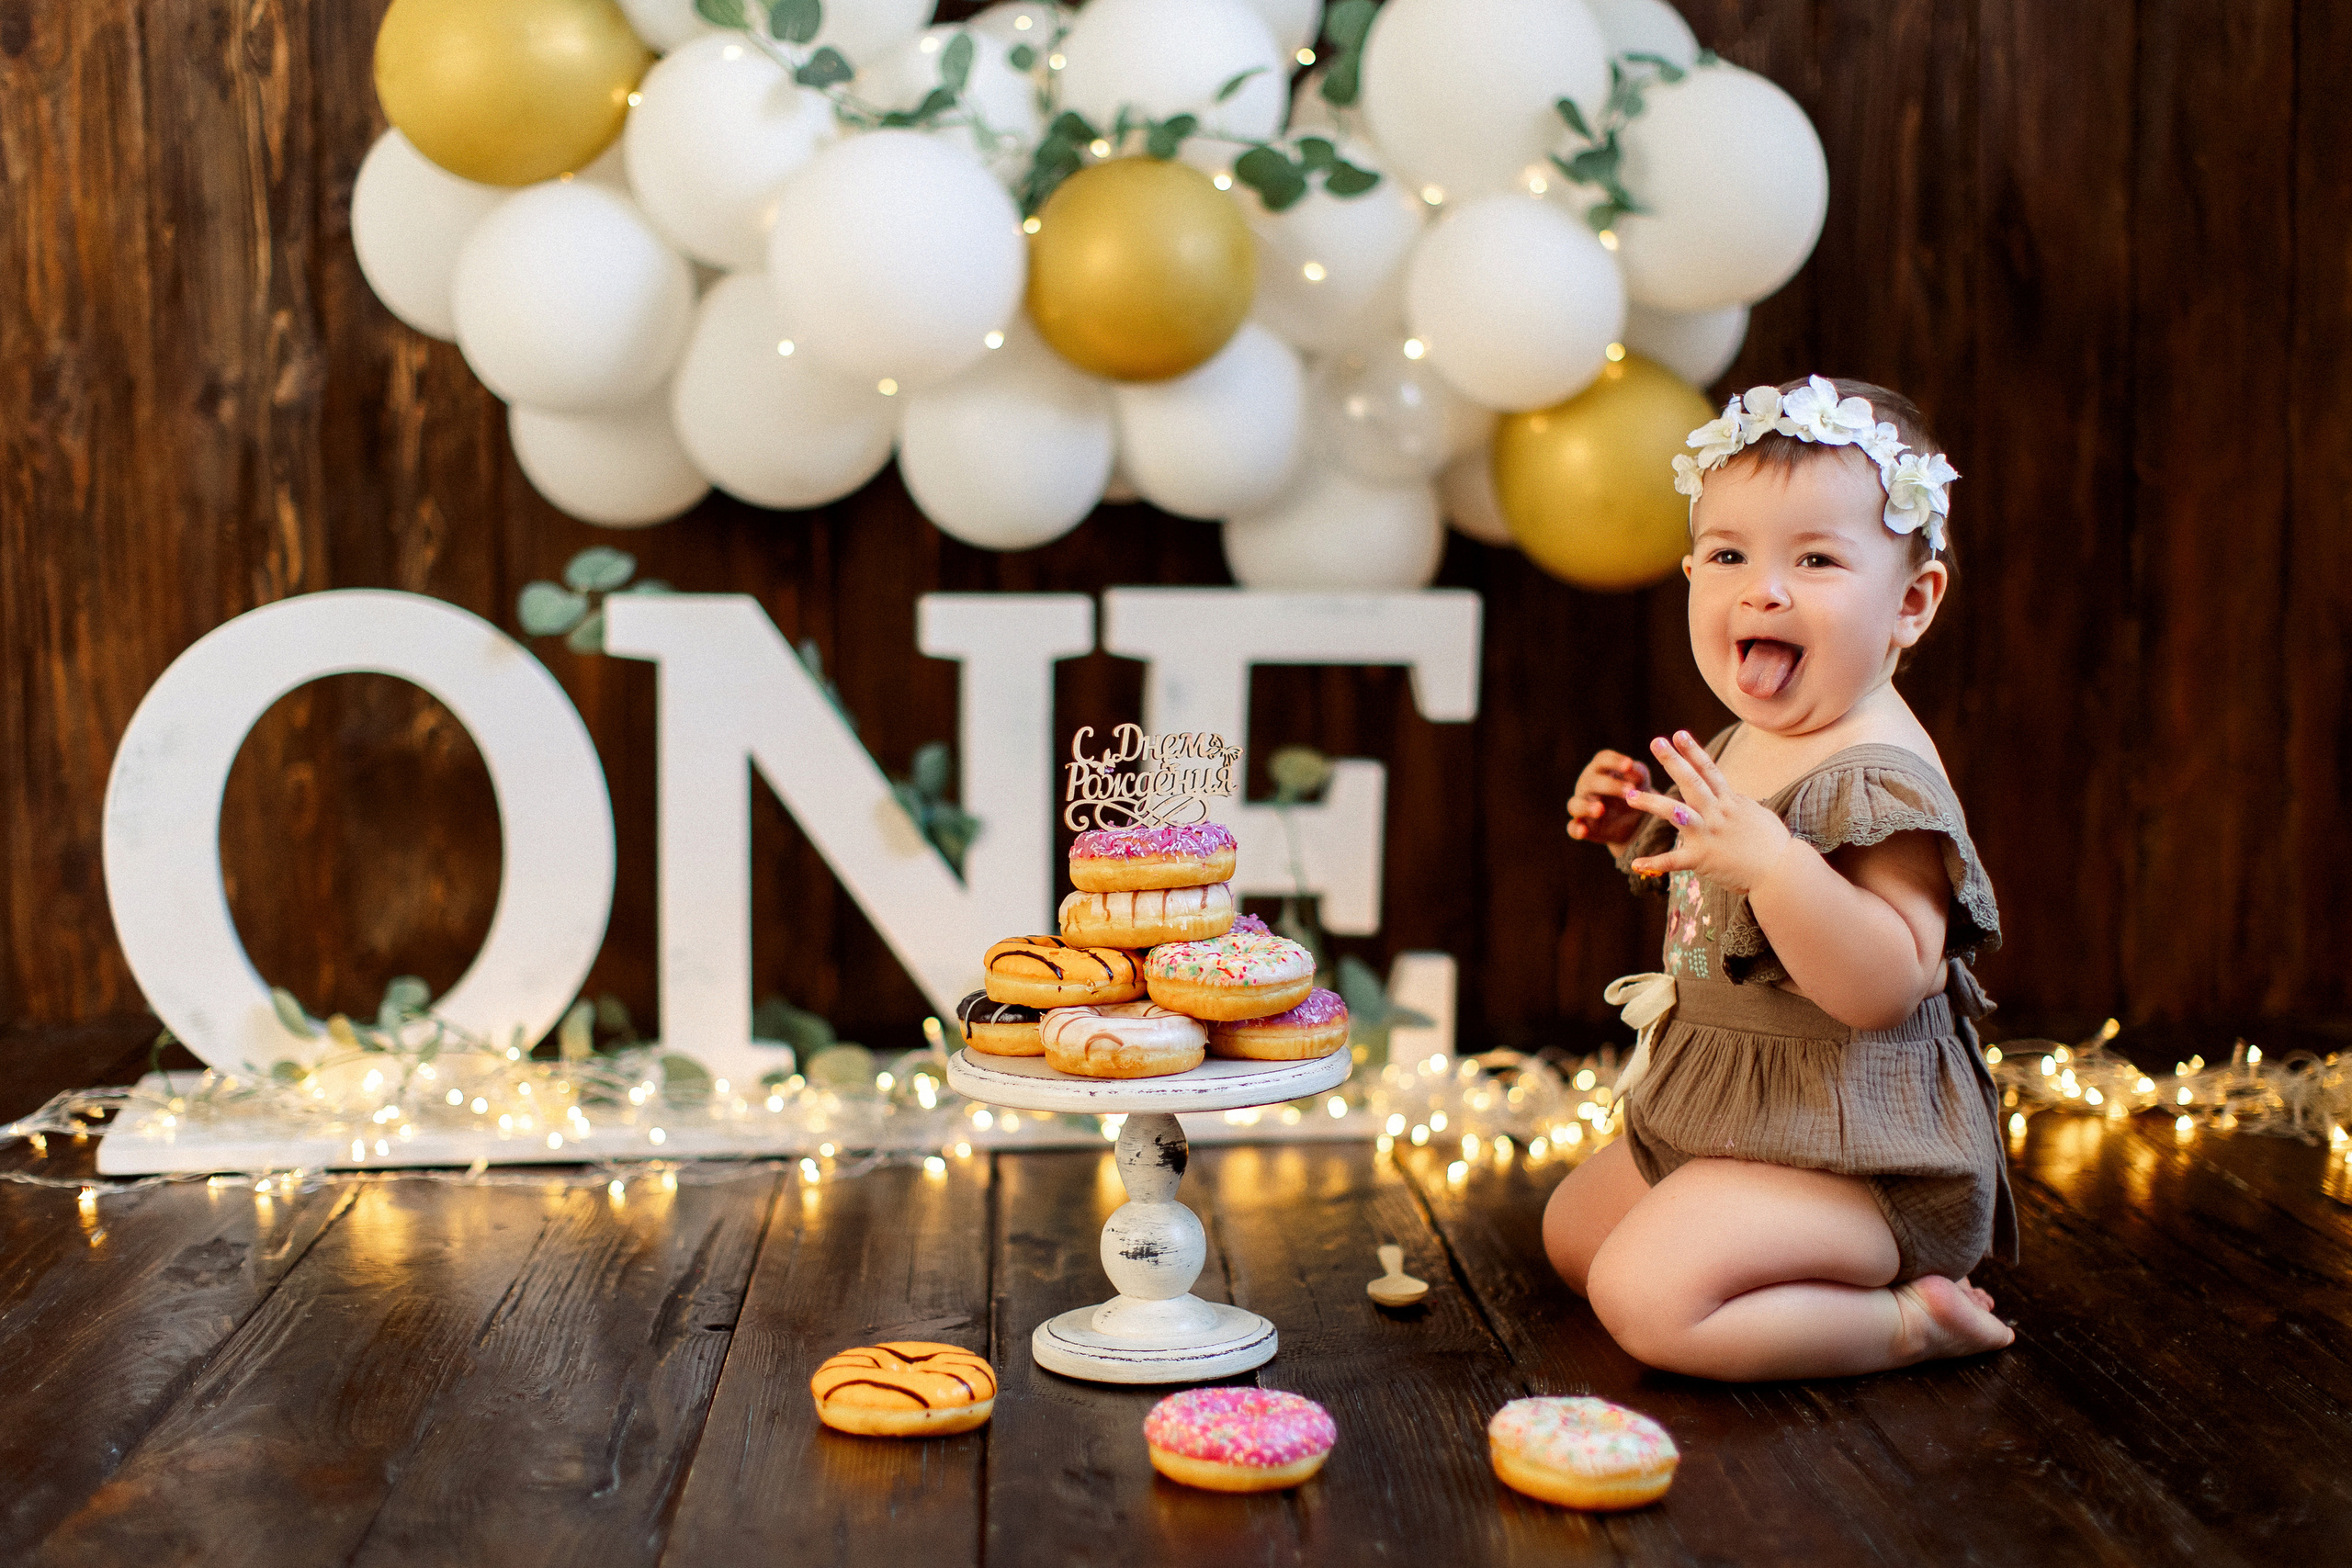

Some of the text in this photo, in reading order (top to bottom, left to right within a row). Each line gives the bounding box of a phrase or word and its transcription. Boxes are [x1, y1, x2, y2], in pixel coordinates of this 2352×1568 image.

[1071, 726, 1095, 763] С
[1065, 761, 1238, 814] Рождения
[101, 588, 1484, 1084] ONE
